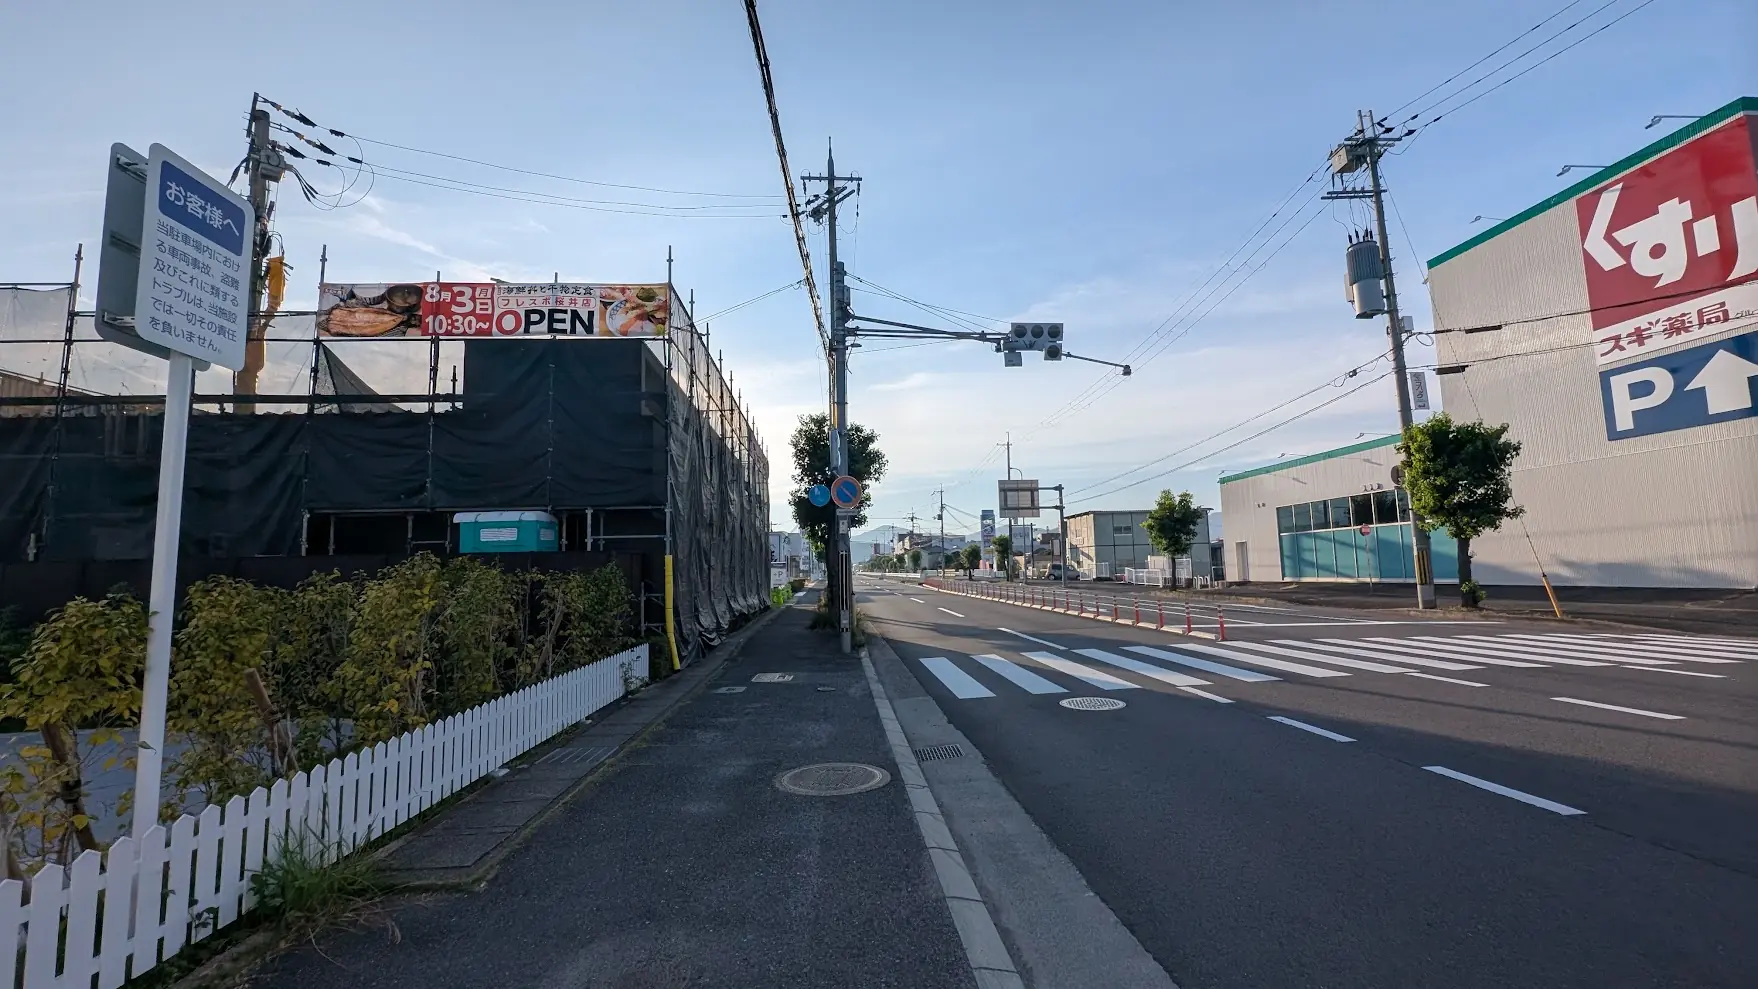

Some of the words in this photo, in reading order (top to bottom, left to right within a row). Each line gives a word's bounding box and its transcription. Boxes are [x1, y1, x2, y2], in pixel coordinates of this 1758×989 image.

[166, 180, 240, 237] お客様へ
[1583, 181, 1758, 288] くすり
[156, 218, 241, 273] 当駐車場内におけ
[156, 239, 240, 291] る車両事故、盗難
[152, 277, 238, 325] トラブルは、当施設
[153, 257, 239, 307] 及びこれに類する
[149, 317, 222, 354] を負いません。
[151, 297, 237, 342] では一切その責任
[496, 309, 594, 335] OPEN
[1600, 301, 1730, 358] スギ薬局
[1610, 366, 1675, 432] P
